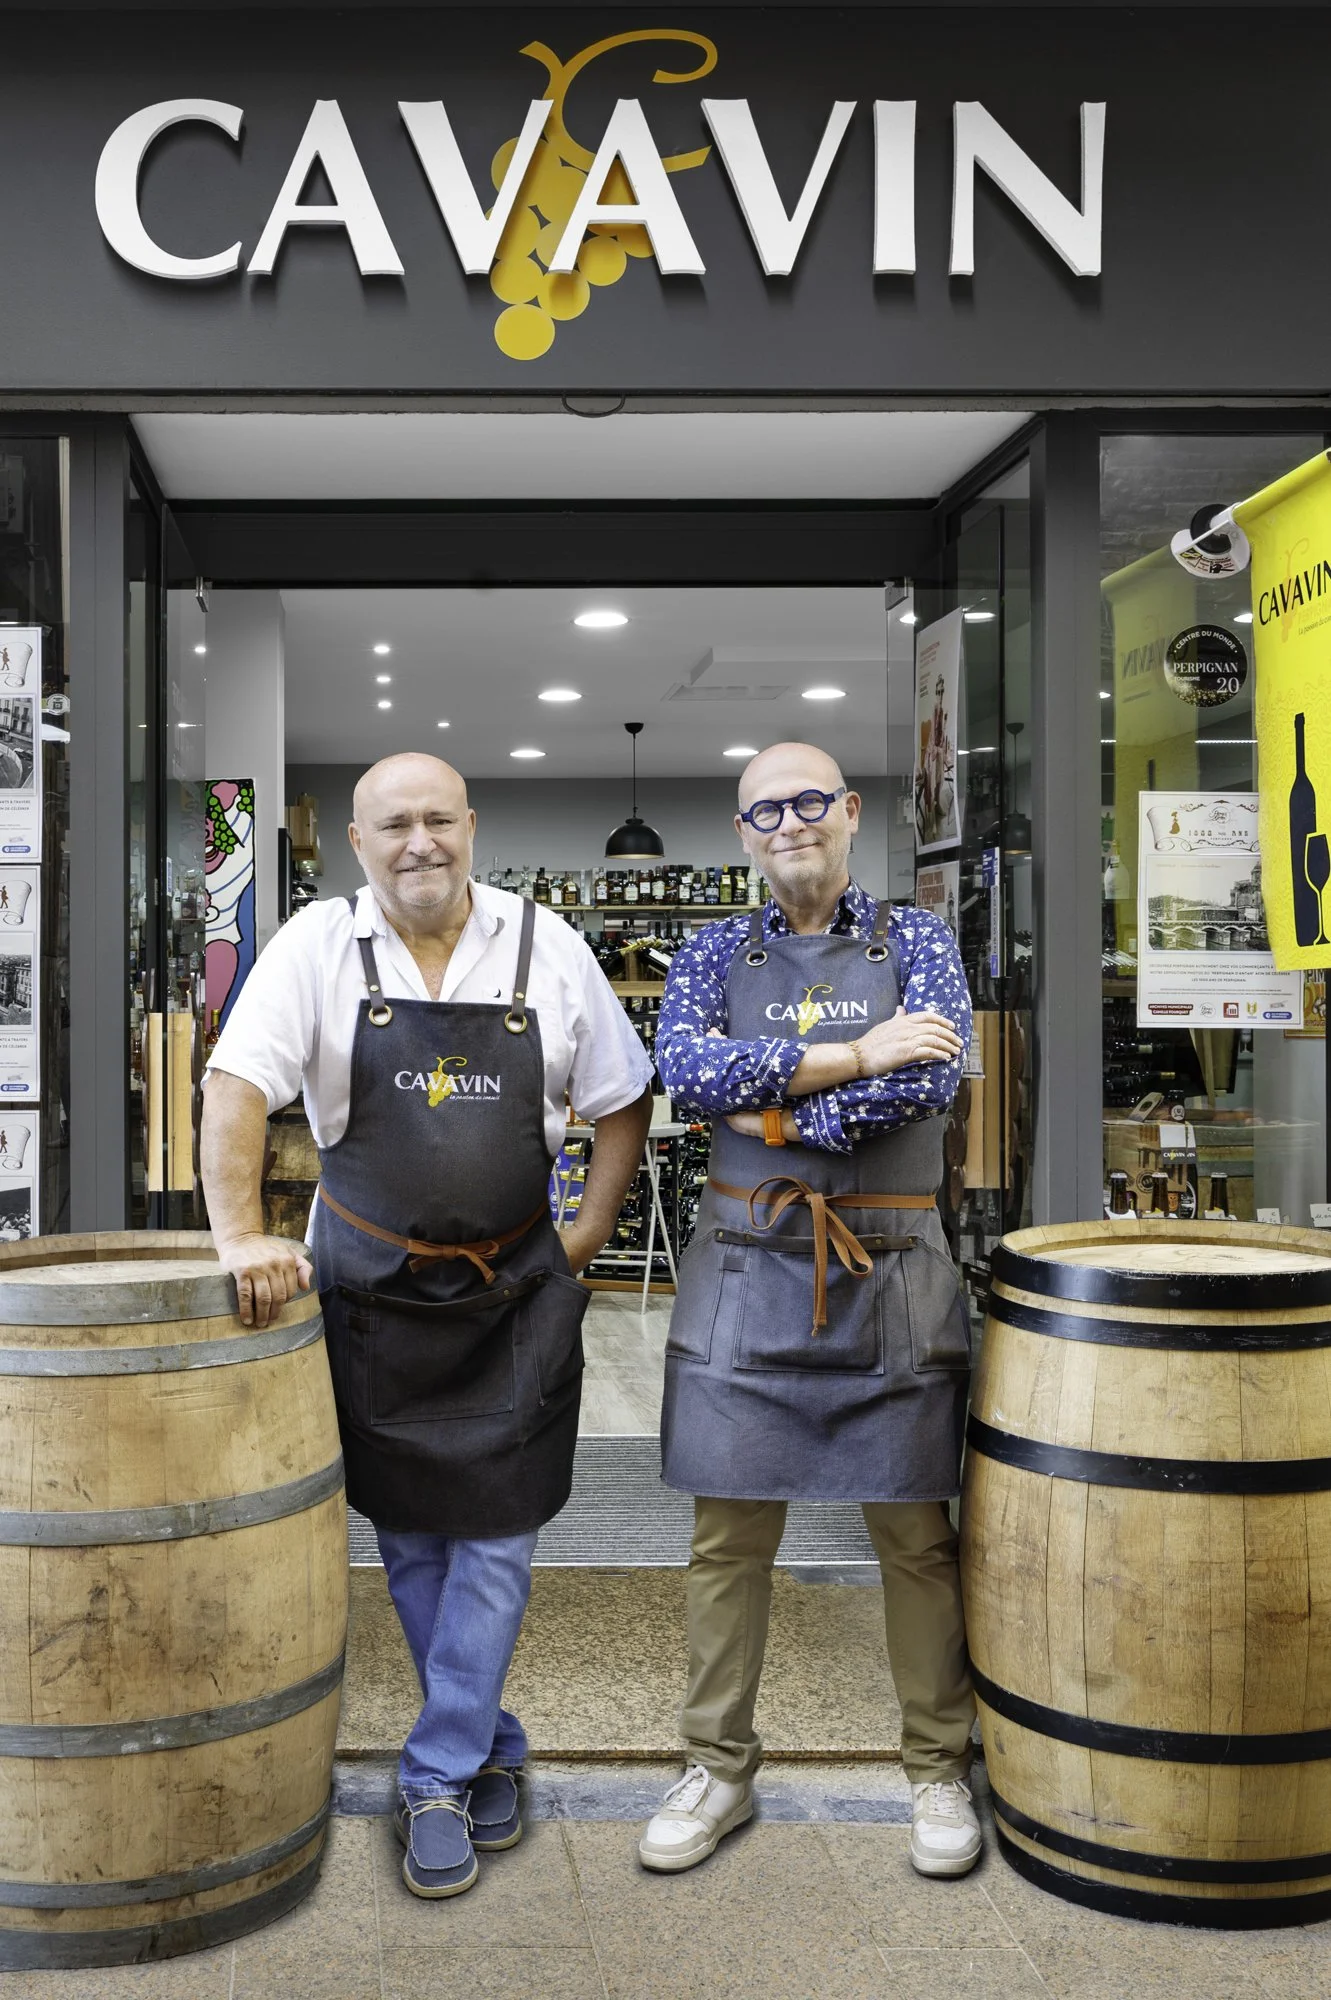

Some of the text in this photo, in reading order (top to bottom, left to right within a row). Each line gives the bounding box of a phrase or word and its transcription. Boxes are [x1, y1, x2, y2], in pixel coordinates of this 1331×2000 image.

[94, 96, 1108, 279] CAVAVIN
[1175, 631, 1200, 649] CENTRE
[1213, 631, 1237, 650] MONDE
[1173, 662, 1239, 673] PERPIGNAN
[1216, 677, 1240, 694] 20
[764, 1000, 869, 1021] CAVAVIN
[394, 1070, 501, 1093] CAVAVIN
